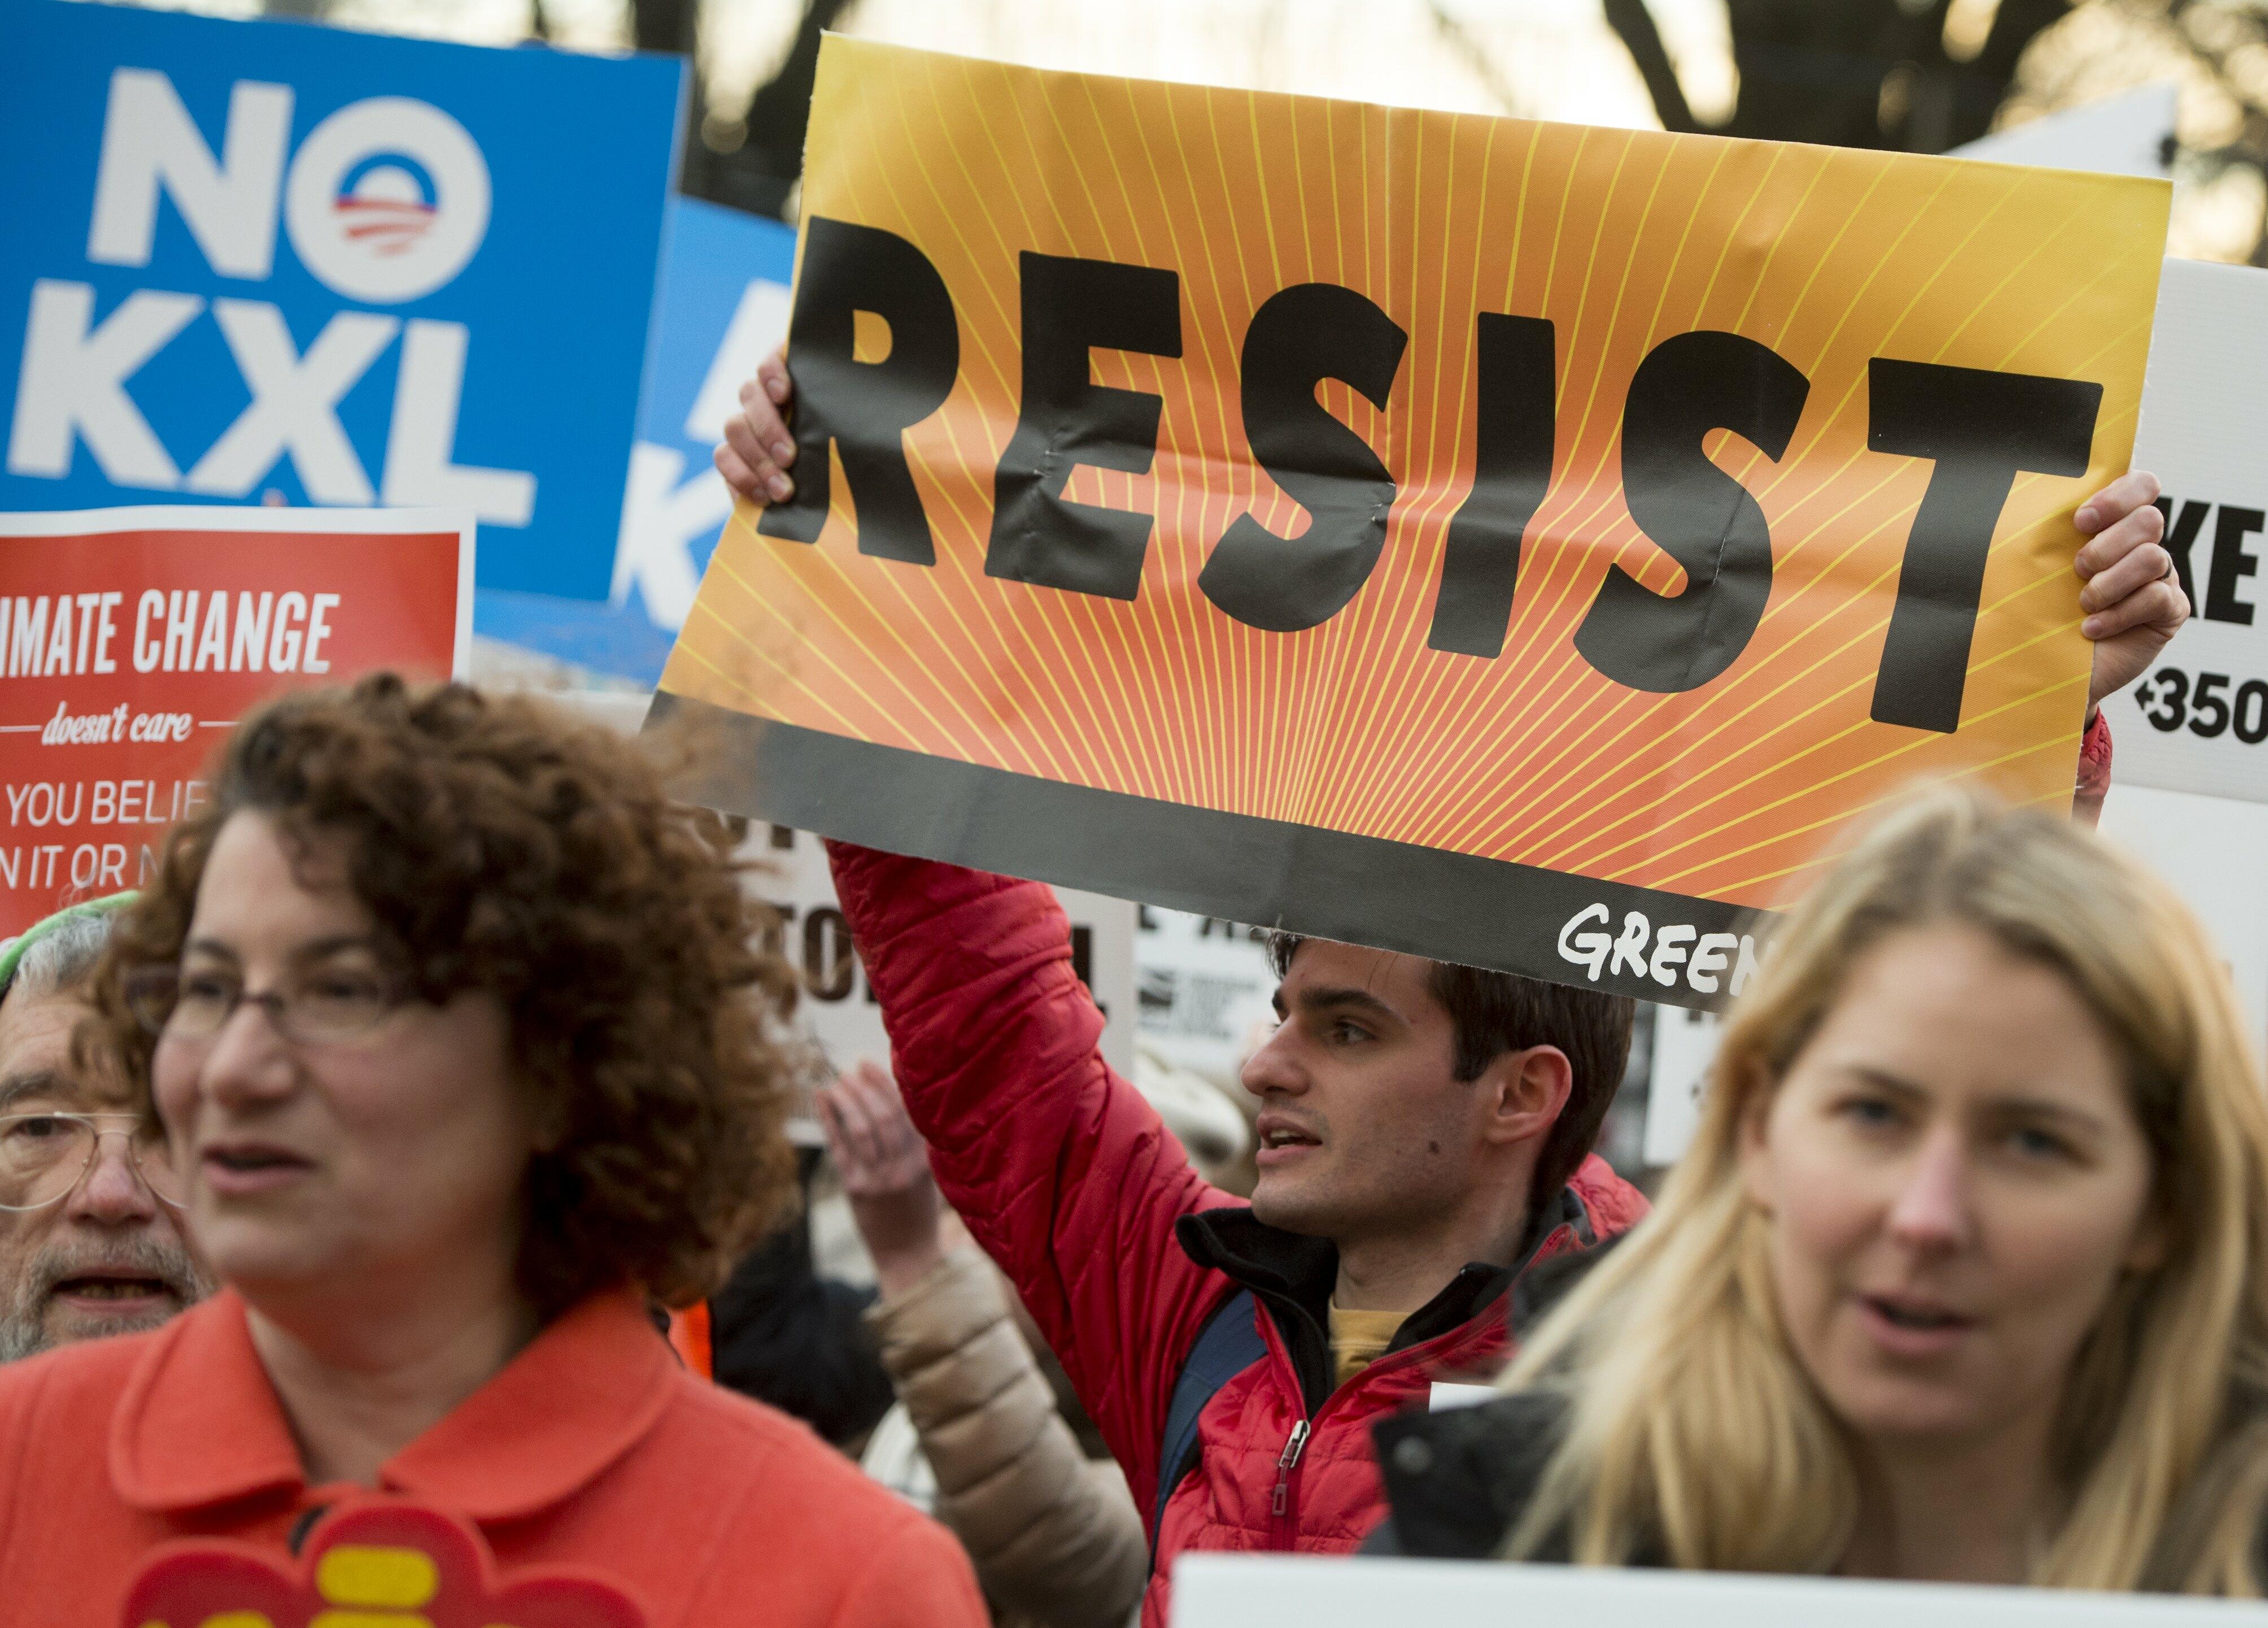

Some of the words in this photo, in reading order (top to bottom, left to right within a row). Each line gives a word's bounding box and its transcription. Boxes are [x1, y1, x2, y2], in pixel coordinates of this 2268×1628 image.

[86, 65, 494, 304] NO
[5, 277, 538, 528] KXL
[757, 215, 2104, 734] RESIST
[133, 589, 341, 675] CHANGE
[41, 700, 129, 746] doesn't
[129, 712, 194, 743] care
[6, 781, 84, 827] YOU
[29, 845, 66, 890] IT
[71, 843, 127, 890] OR
